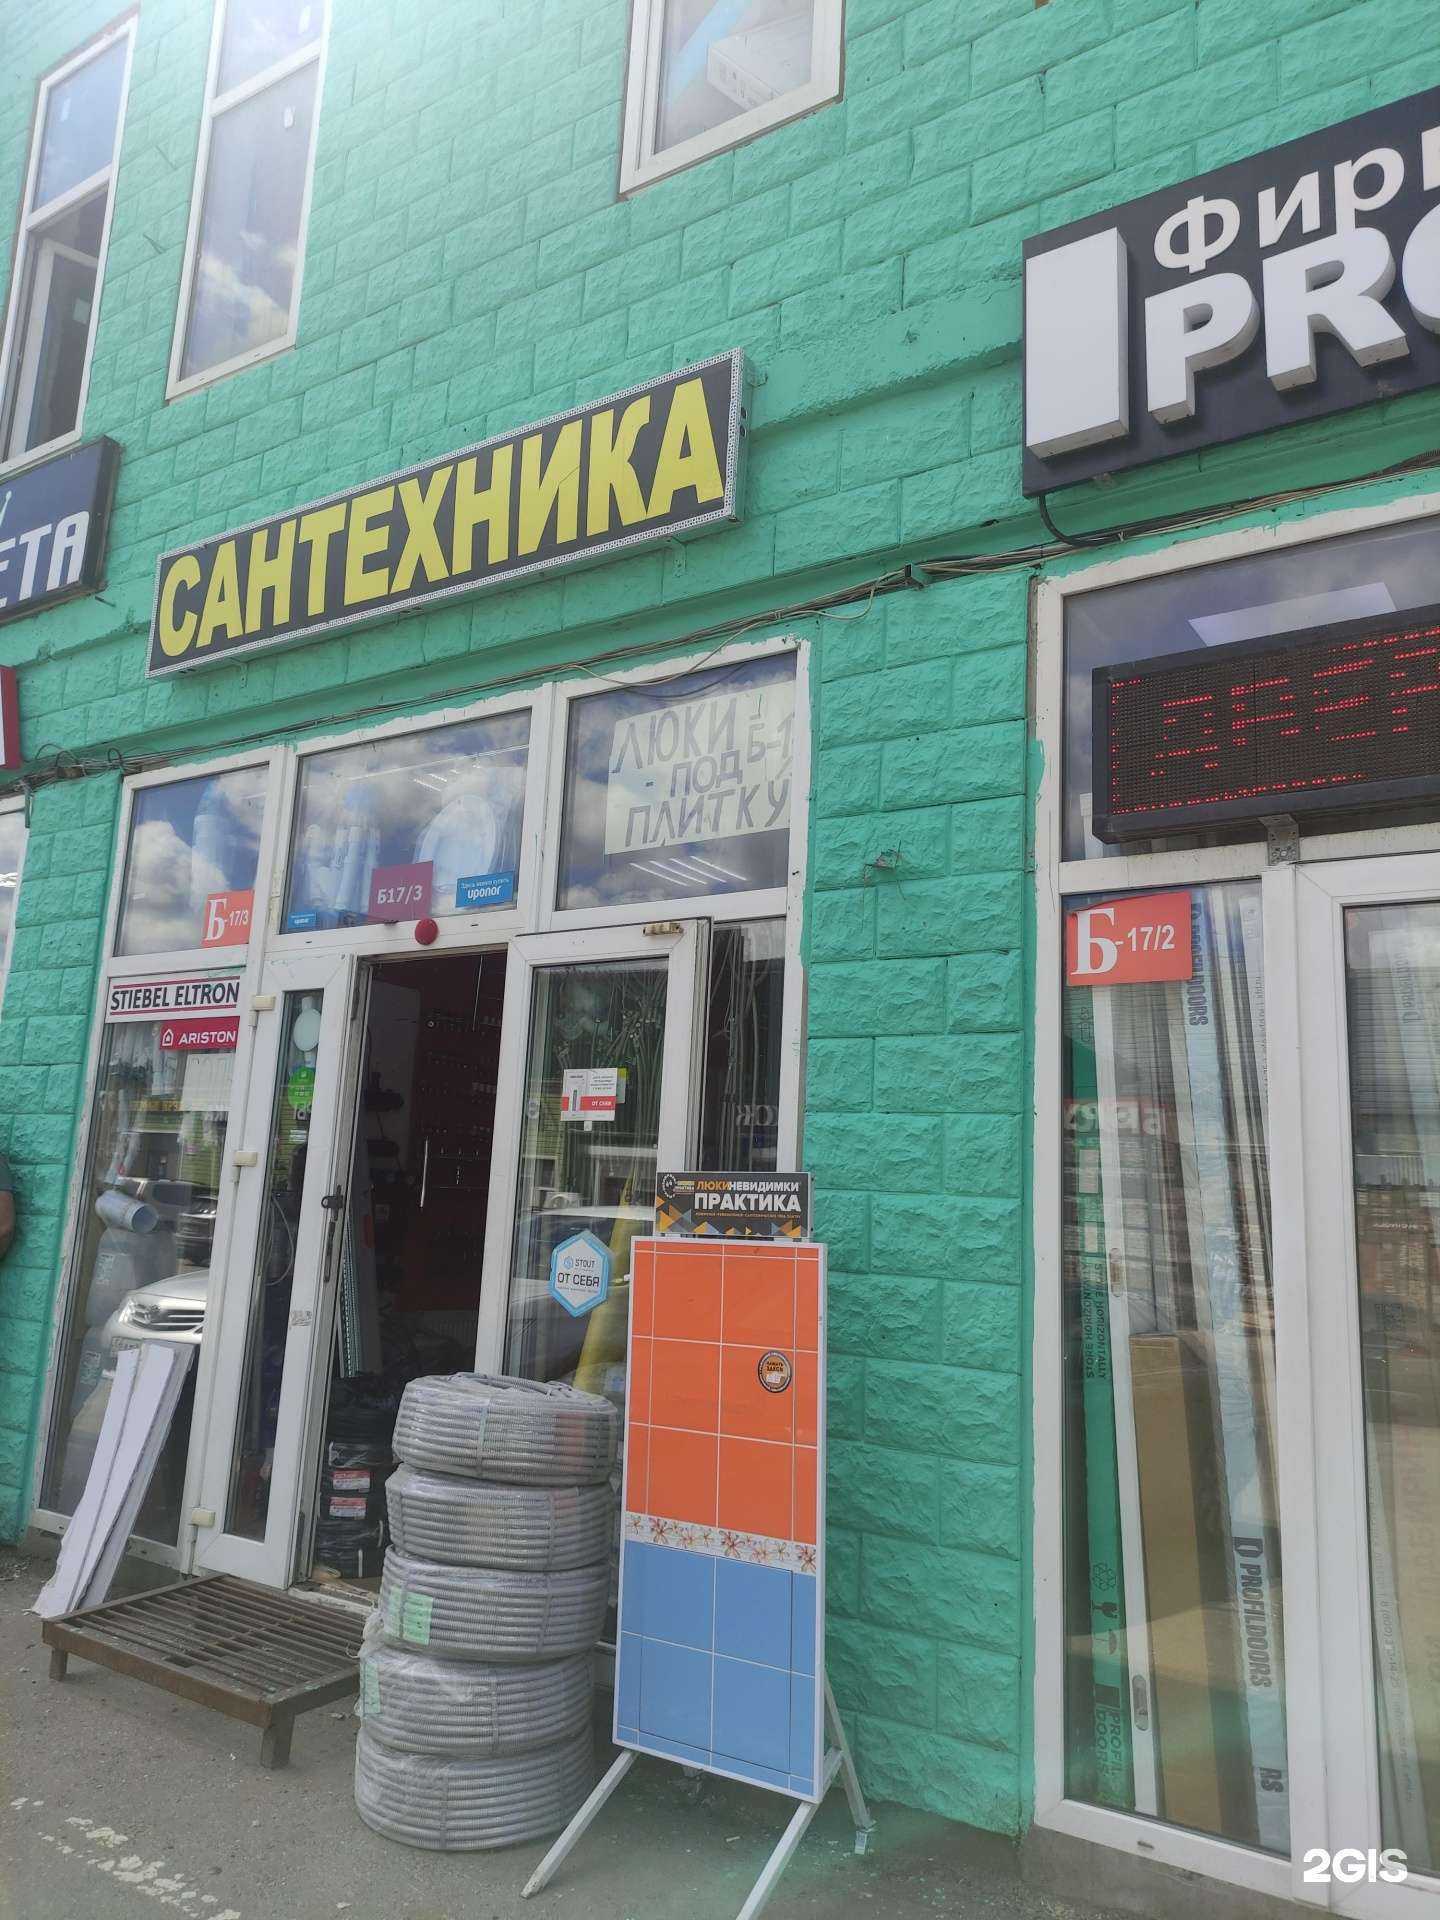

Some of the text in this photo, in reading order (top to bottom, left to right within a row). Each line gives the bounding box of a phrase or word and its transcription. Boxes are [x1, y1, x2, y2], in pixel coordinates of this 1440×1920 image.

[1145, 201, 1440, 425] PR
[159, 378, 724, 658] САНТЕХНИКА
[609, 697, 738, 774] ЛЮКИ
[670, 749, 743, 798] ПОД
[625, 777, 790, 848] ПЛИТКУ
[467, 885, 502, 901] uponor
[1071, 907, 1175, 976] Б-17/2
[110, 981, 240, 1011] STIEBEL ELTRON
[178, 1030, 237, 1046] ARISTON
[694, 1192, 802, 1213] ПРАКТИКА
[557, 1272, 600, 1288] ОТ СЕБЯ
[575, 1258, 596, 1268] STOUT
[1240, 1563, 1272, 1688] PROFILDOORS
